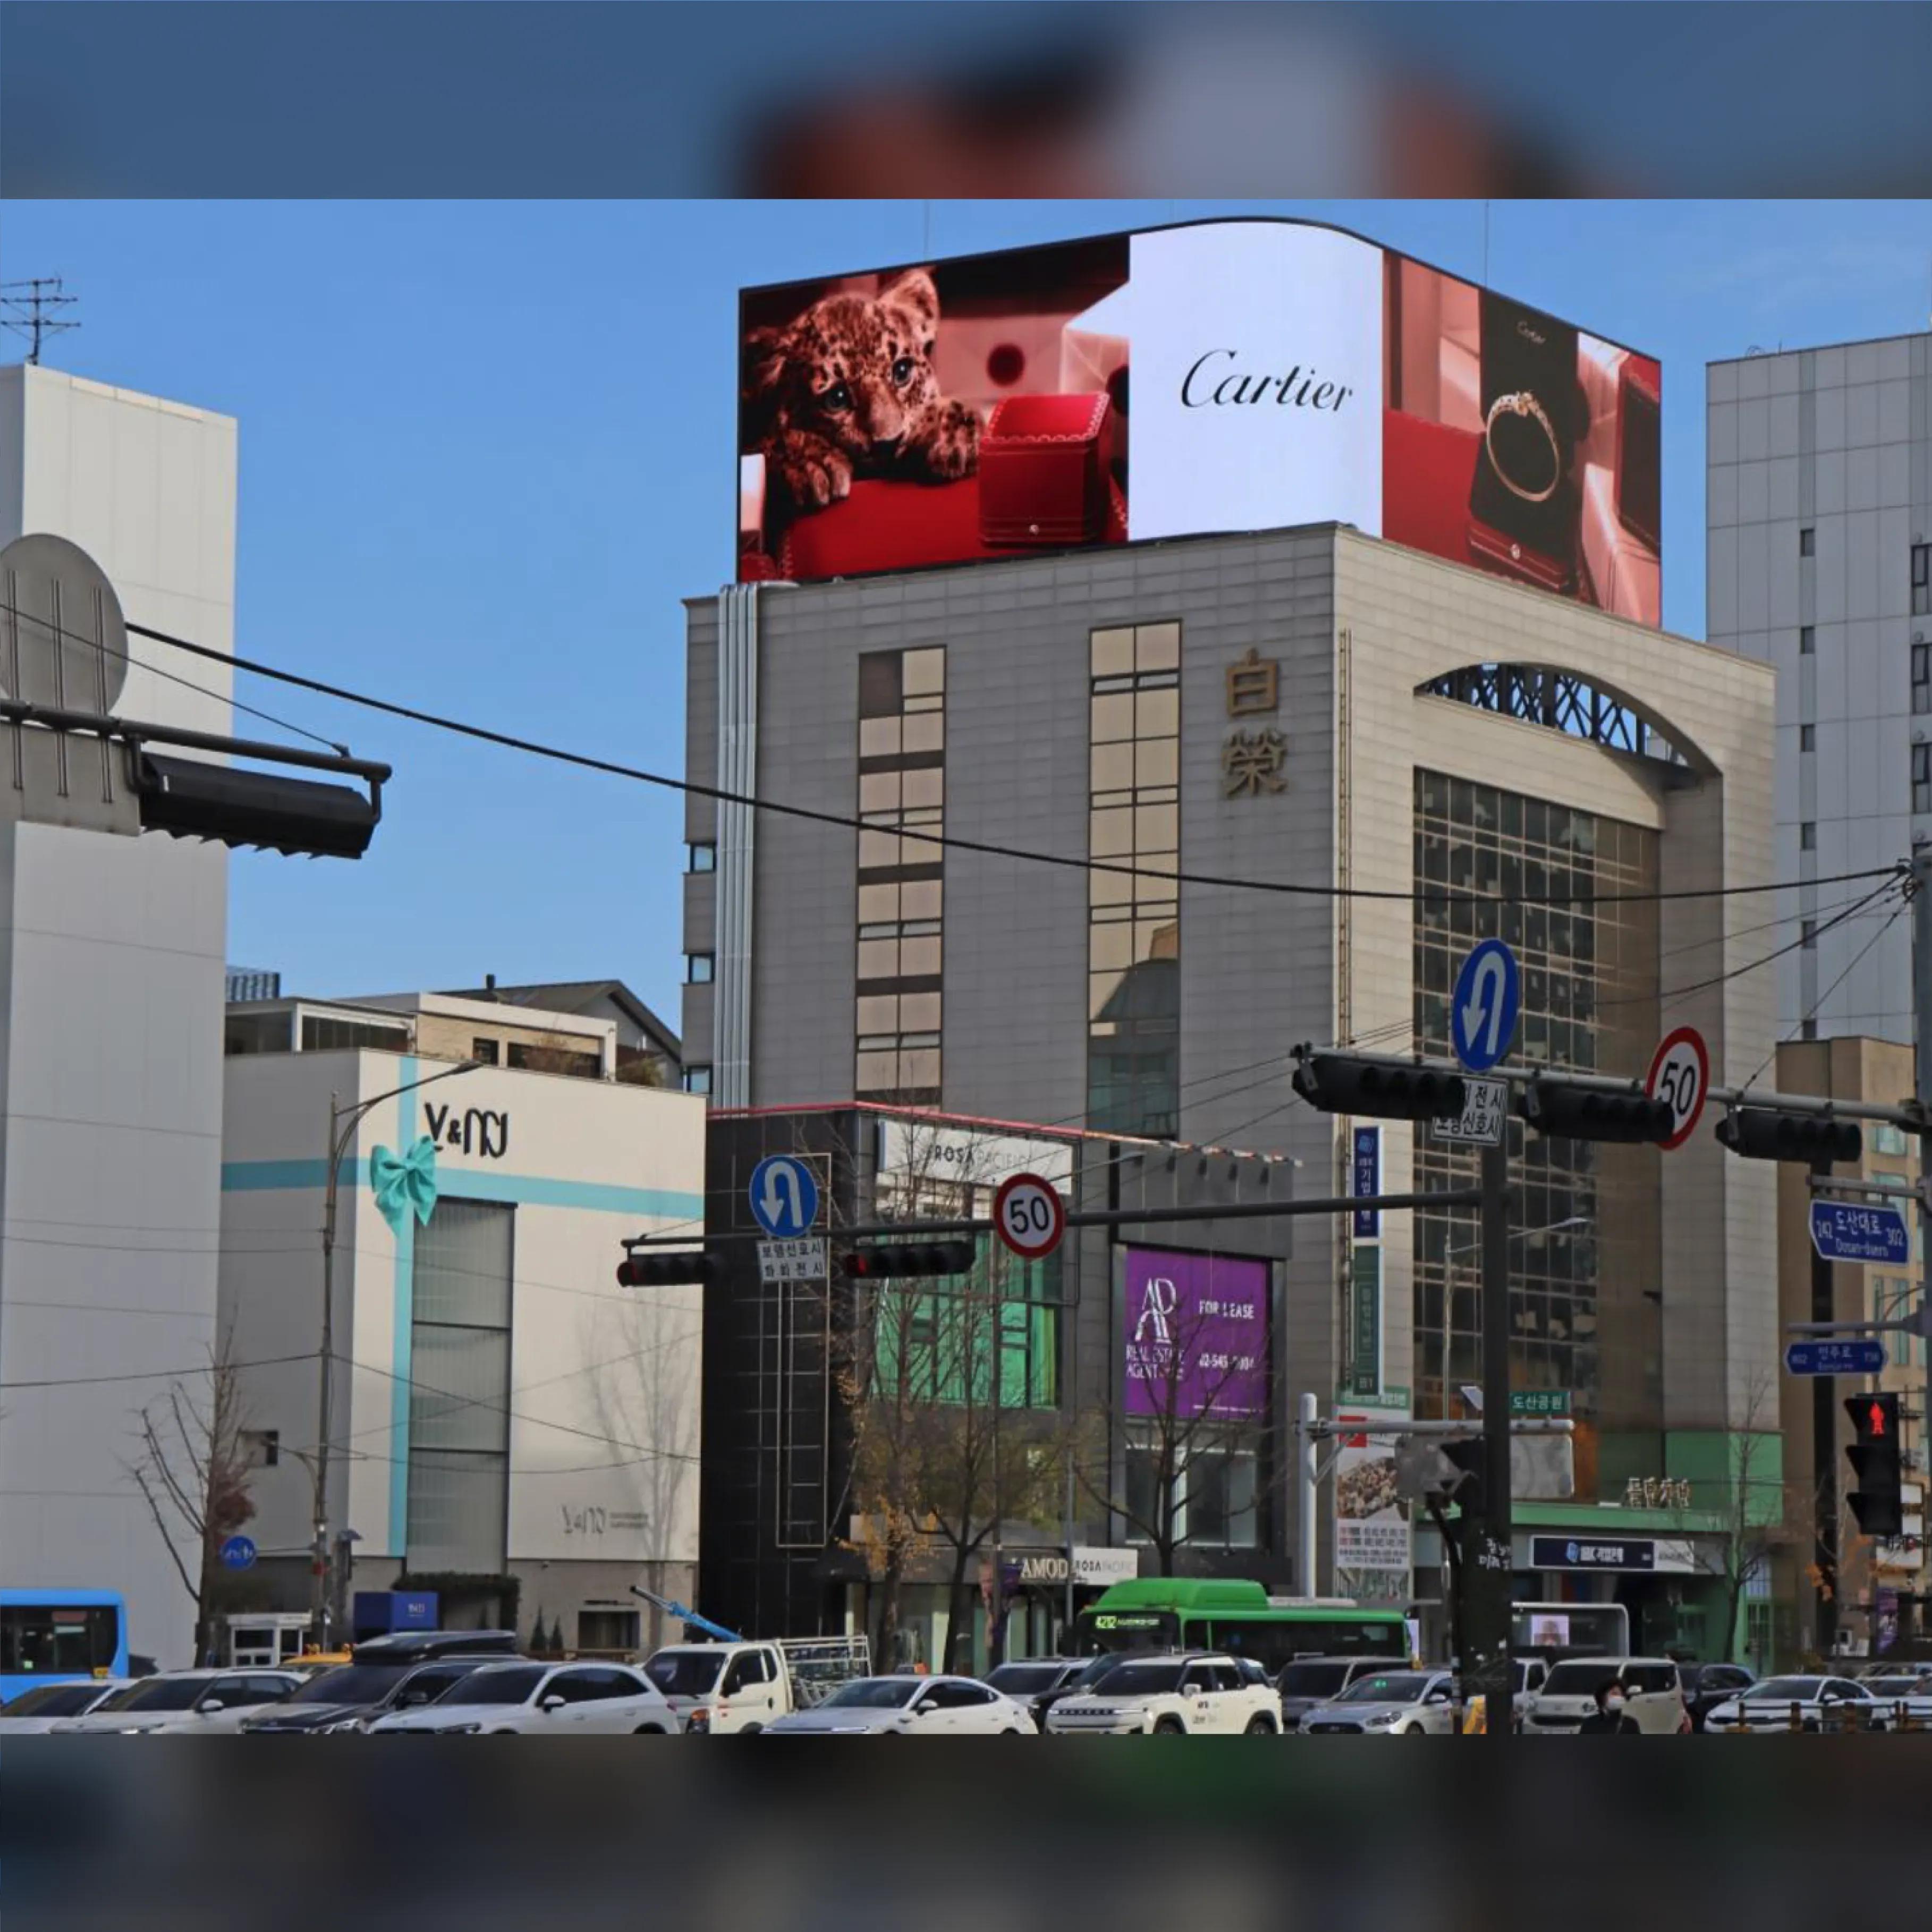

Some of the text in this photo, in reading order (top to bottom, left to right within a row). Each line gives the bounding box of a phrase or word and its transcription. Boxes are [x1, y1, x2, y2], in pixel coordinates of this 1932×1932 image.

[1181, 349, 1353, 411] Cartier
[1658, 1061, 1696, 1115] 50
[1010, 1197, 1049, 1234] 50
[1835, 1210, 1883, 1235] 도산대로
[1199, 1299, 1255, 1319] FOR LEASE
[1512, 1394, 1563, 1410] 도산공원
